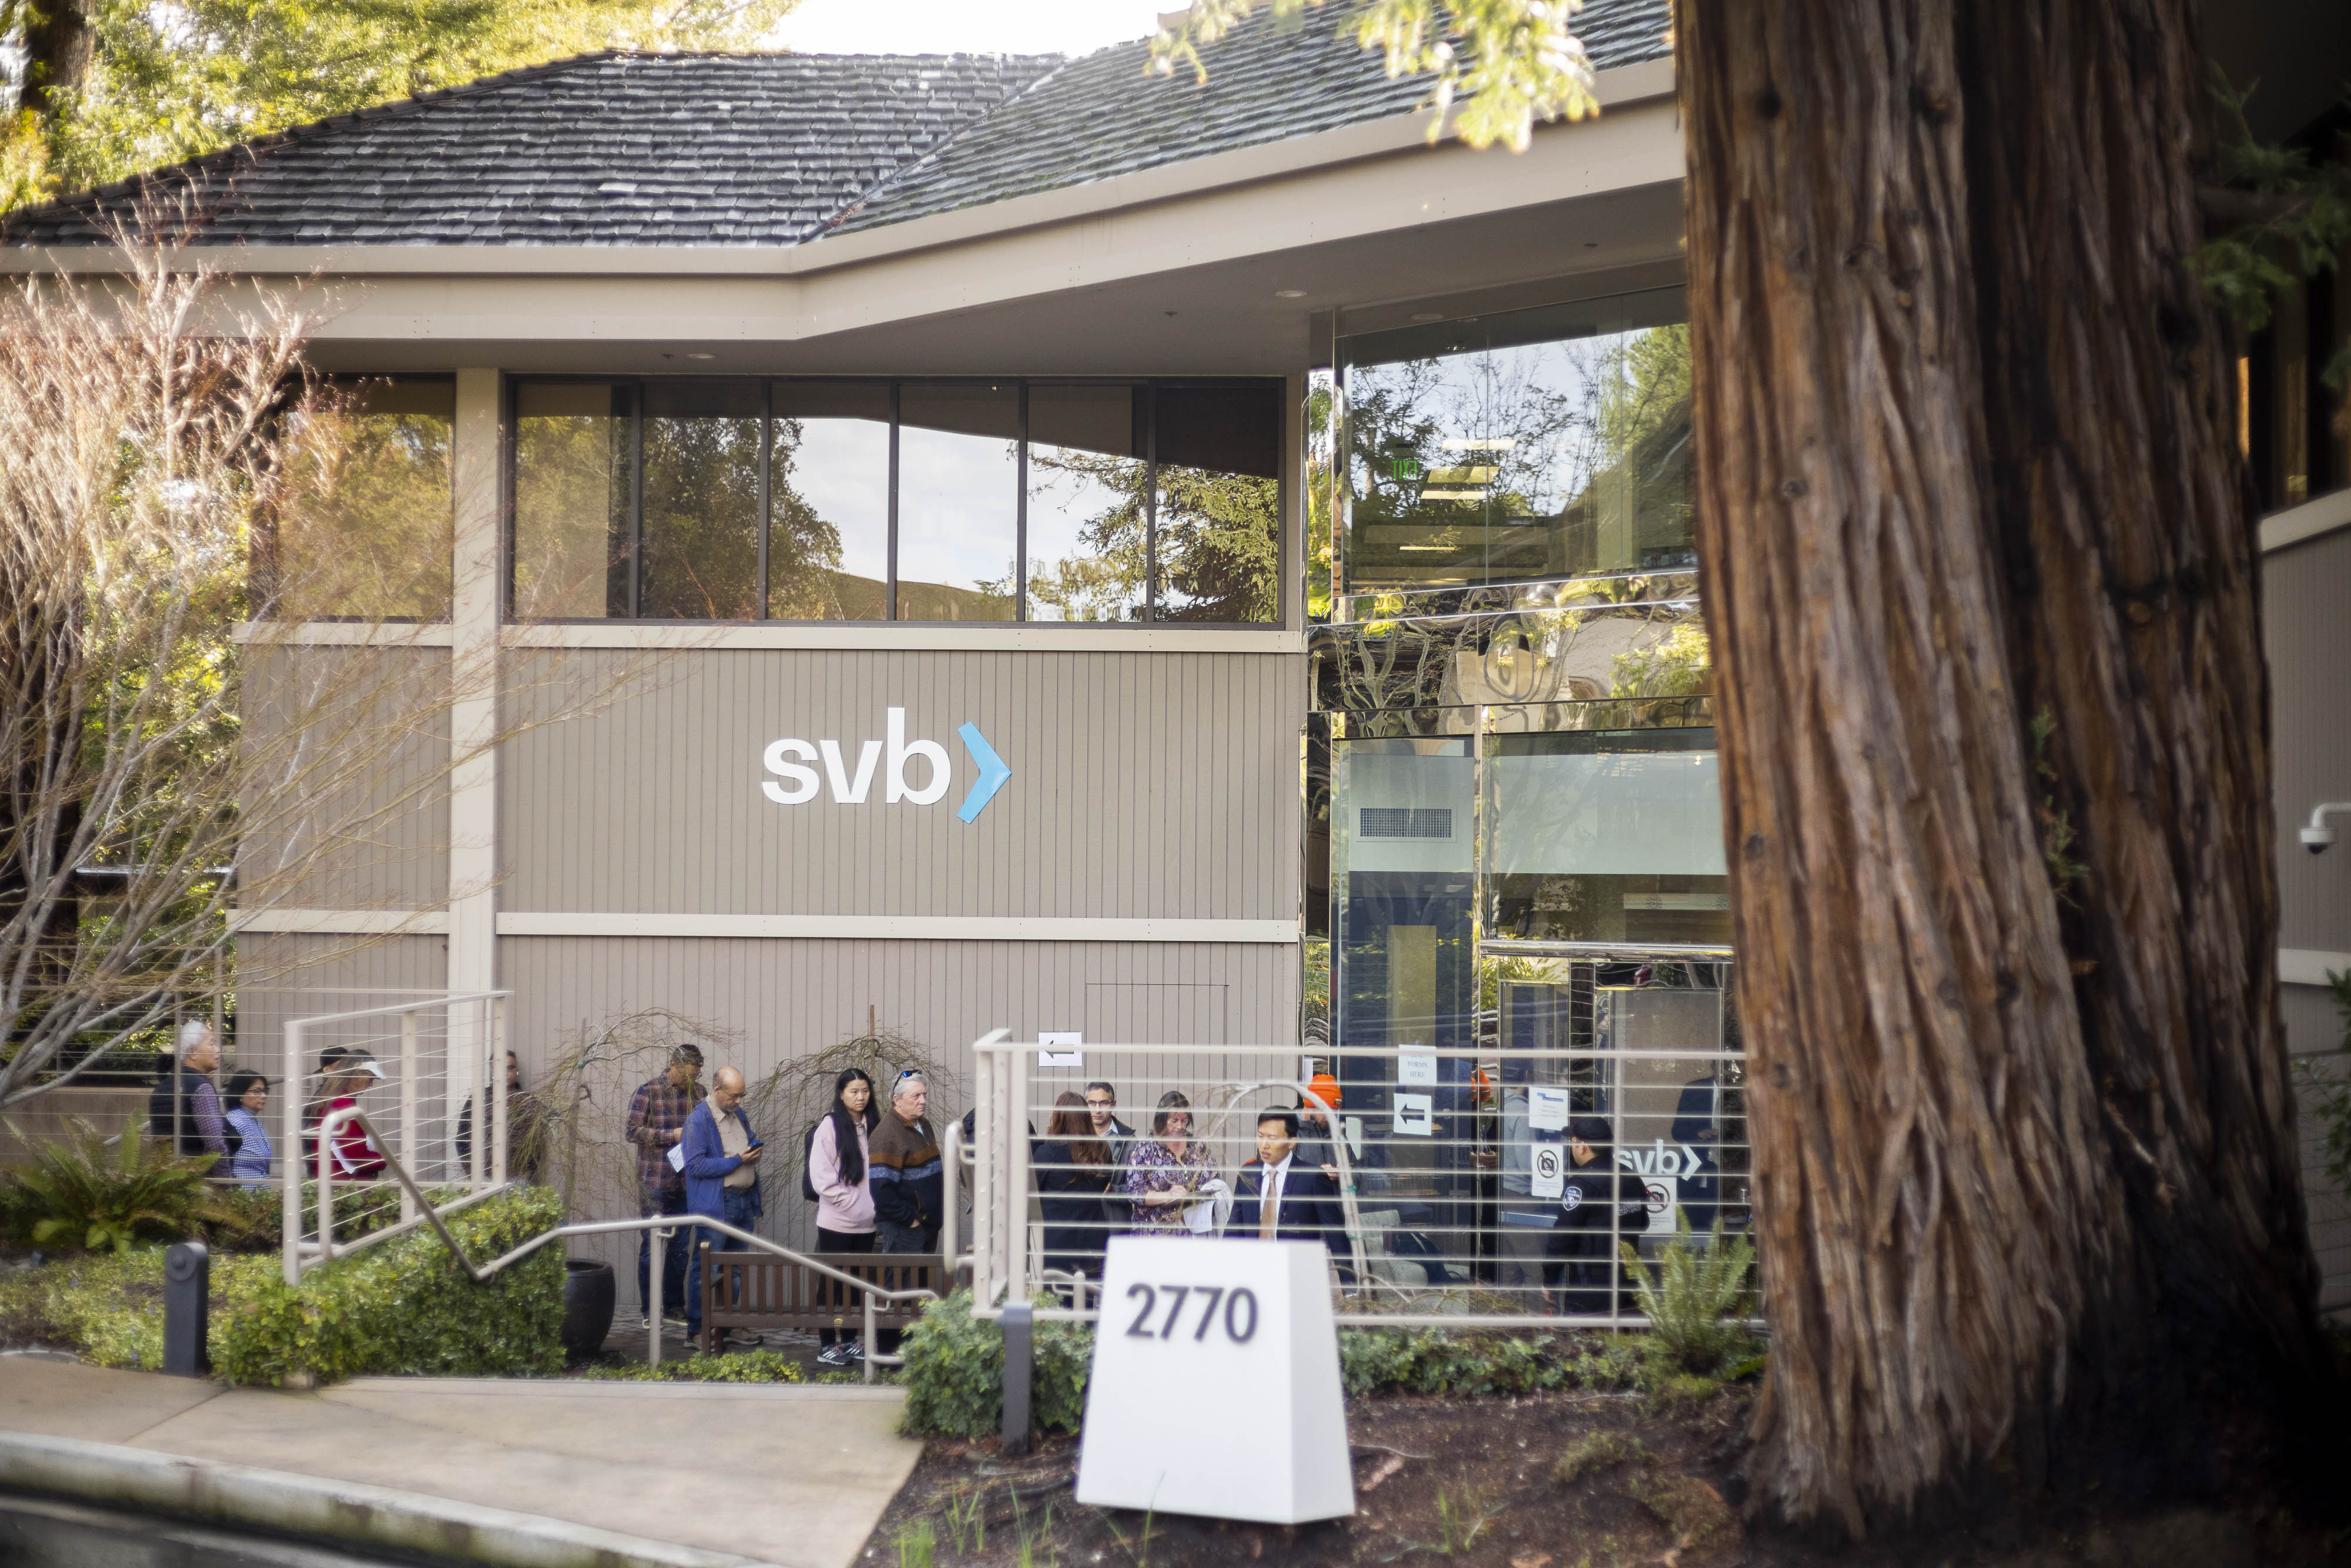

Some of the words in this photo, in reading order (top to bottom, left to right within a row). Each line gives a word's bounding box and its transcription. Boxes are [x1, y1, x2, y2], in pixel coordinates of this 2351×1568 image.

[762, 708, 951, 805] svb
[1613, 1139, 1680, 1175] svb
[1125, 1283, 1258, 1343] 2770
